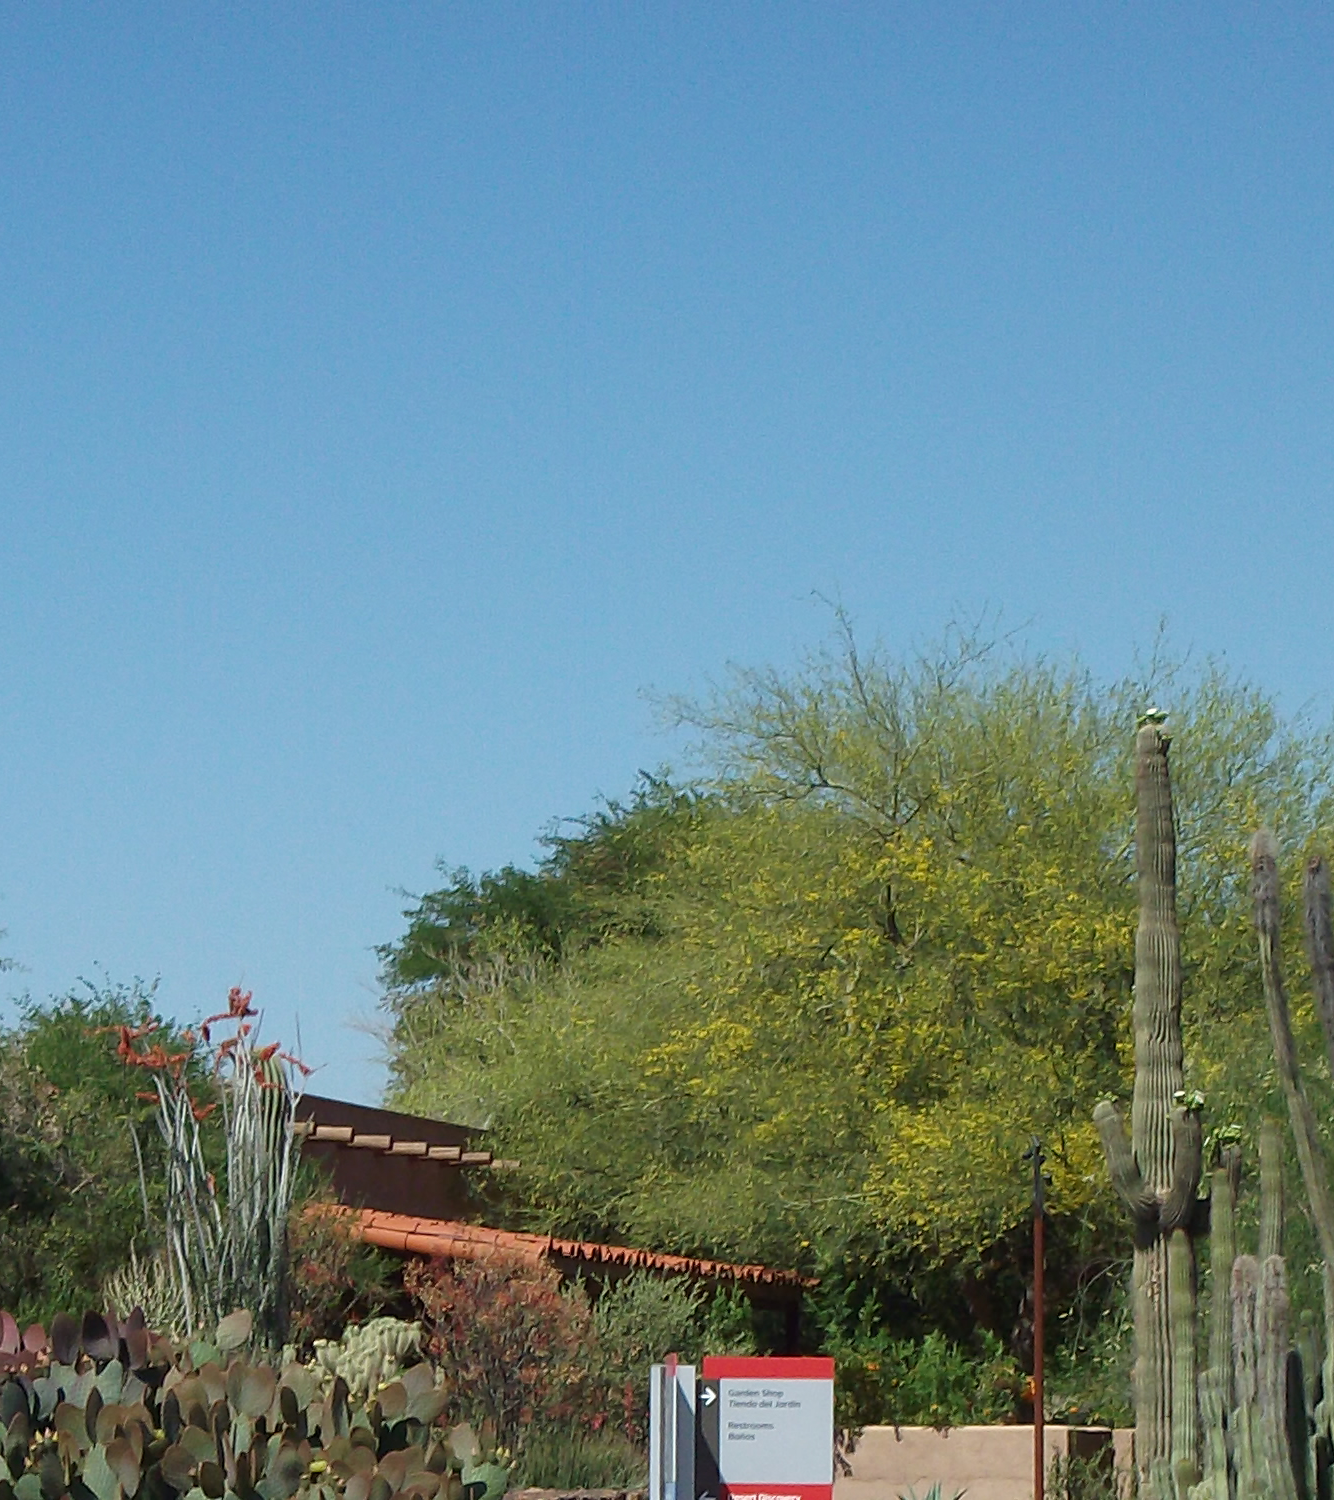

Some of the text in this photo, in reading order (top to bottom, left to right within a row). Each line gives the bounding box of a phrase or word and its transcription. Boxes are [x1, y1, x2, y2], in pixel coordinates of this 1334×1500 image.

[728, 1389, 784, 1399] Garden Shop
[729, 1400, 757, 1408] Tienda
[759, 1400, 772, 1408] del
[728, 1422, 774, 1430] Restrooms
